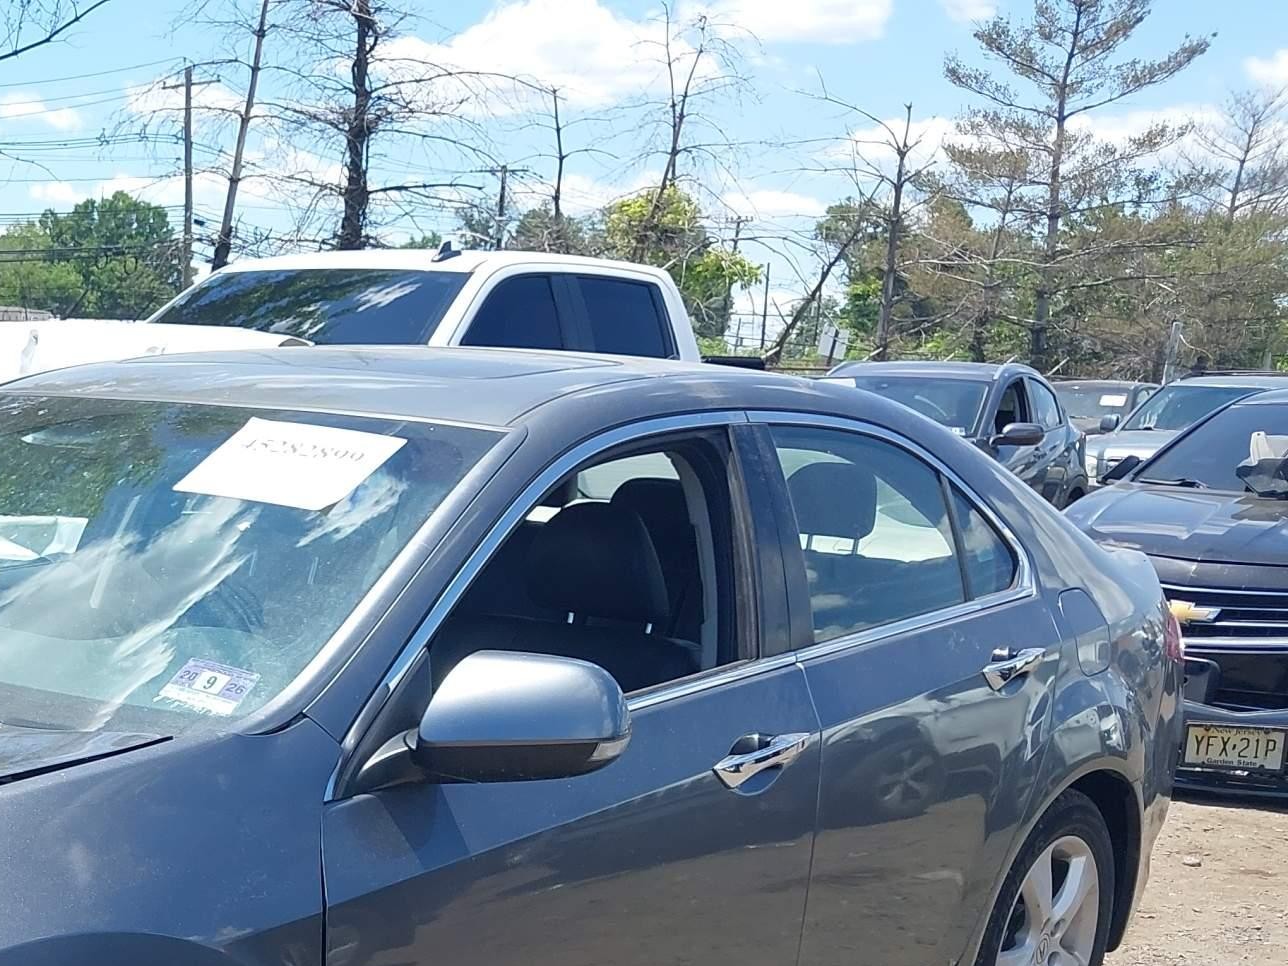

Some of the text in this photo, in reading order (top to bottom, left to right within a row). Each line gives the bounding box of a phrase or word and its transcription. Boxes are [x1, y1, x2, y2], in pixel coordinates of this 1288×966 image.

[179, 670, 199, 681] 20
[202, 675, 218, 690] 9
[225, 683, 246, 695] 26
[1212, 727, 1262, 737] New Jersey
[1206, 757, 1258, 767] Garden State
